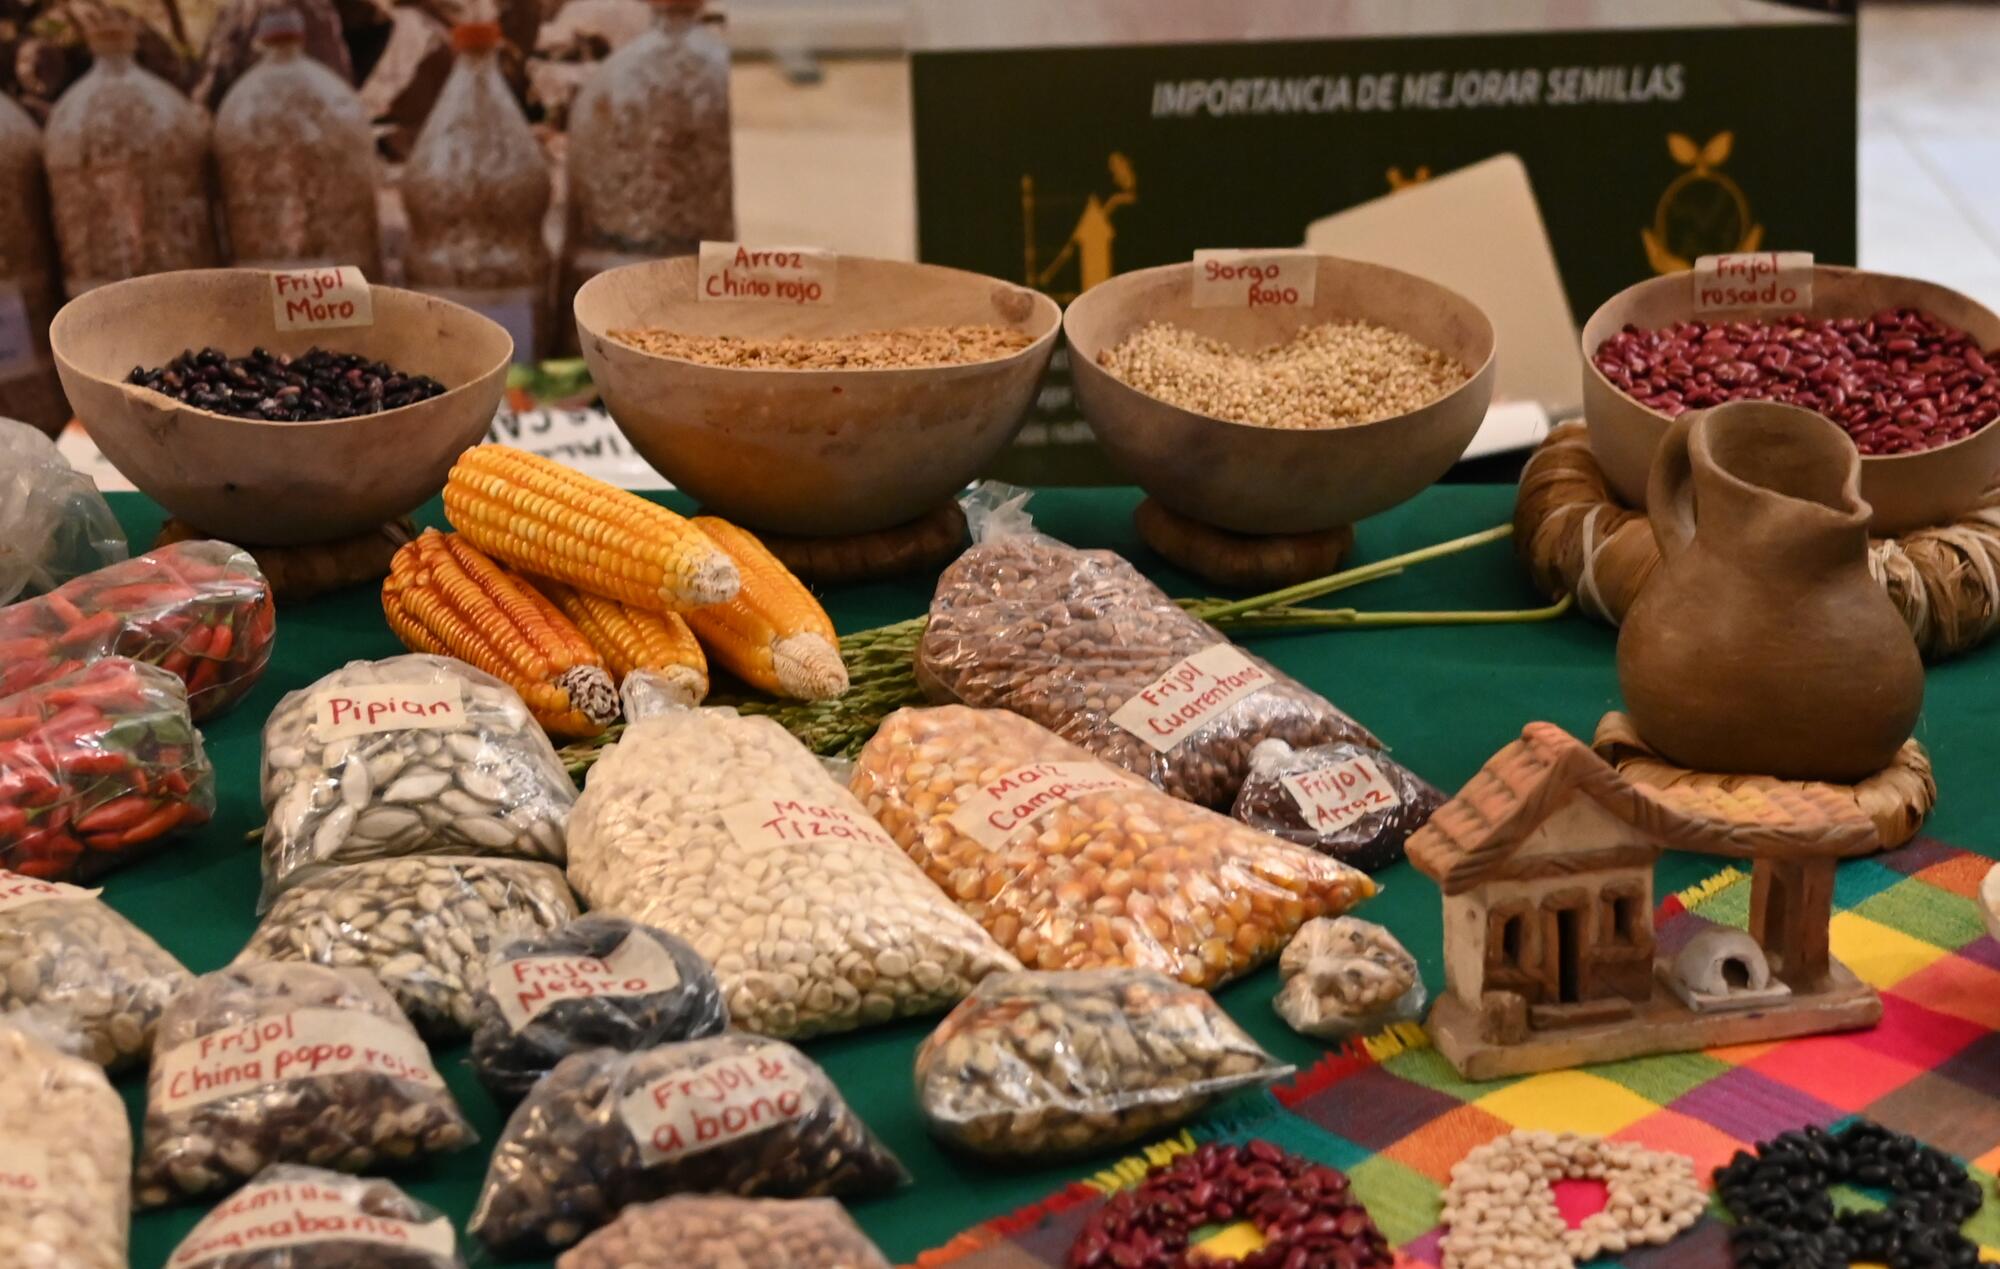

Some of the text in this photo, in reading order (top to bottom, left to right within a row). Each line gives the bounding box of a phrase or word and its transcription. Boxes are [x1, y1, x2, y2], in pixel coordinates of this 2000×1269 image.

[1152, 64, 1685, 118] IMPORTANCIA DE MEJORAR SEMILLAS
[735, 246, 802, 269] Arroz
[1205, 259, 1280, 286] Sorgo
[1717, 252, 1778, 285] Frijol
[275, 267, 343, 299] Frijol
[706, 269, 822, 304] Chino rojo
[1249, 284, 1299, 308] Rojo
[1701, 281, 1797, 307] rosado
[286, 297, 355, 322] Moro
[1140, 660, 1204, 706] Frijol
[328, 697, 451, 725] Pipian
[1296, 762, 1372, 800] Frijol
[1316, 789, 1392, 827] Arroz
[512, 959, 614, 984] Frijol
[517, 978, 648, 1013] Negro
[200, 1014, 294, 1060] Frijol
[169, 1042, 429, 1100] China popo rojo
